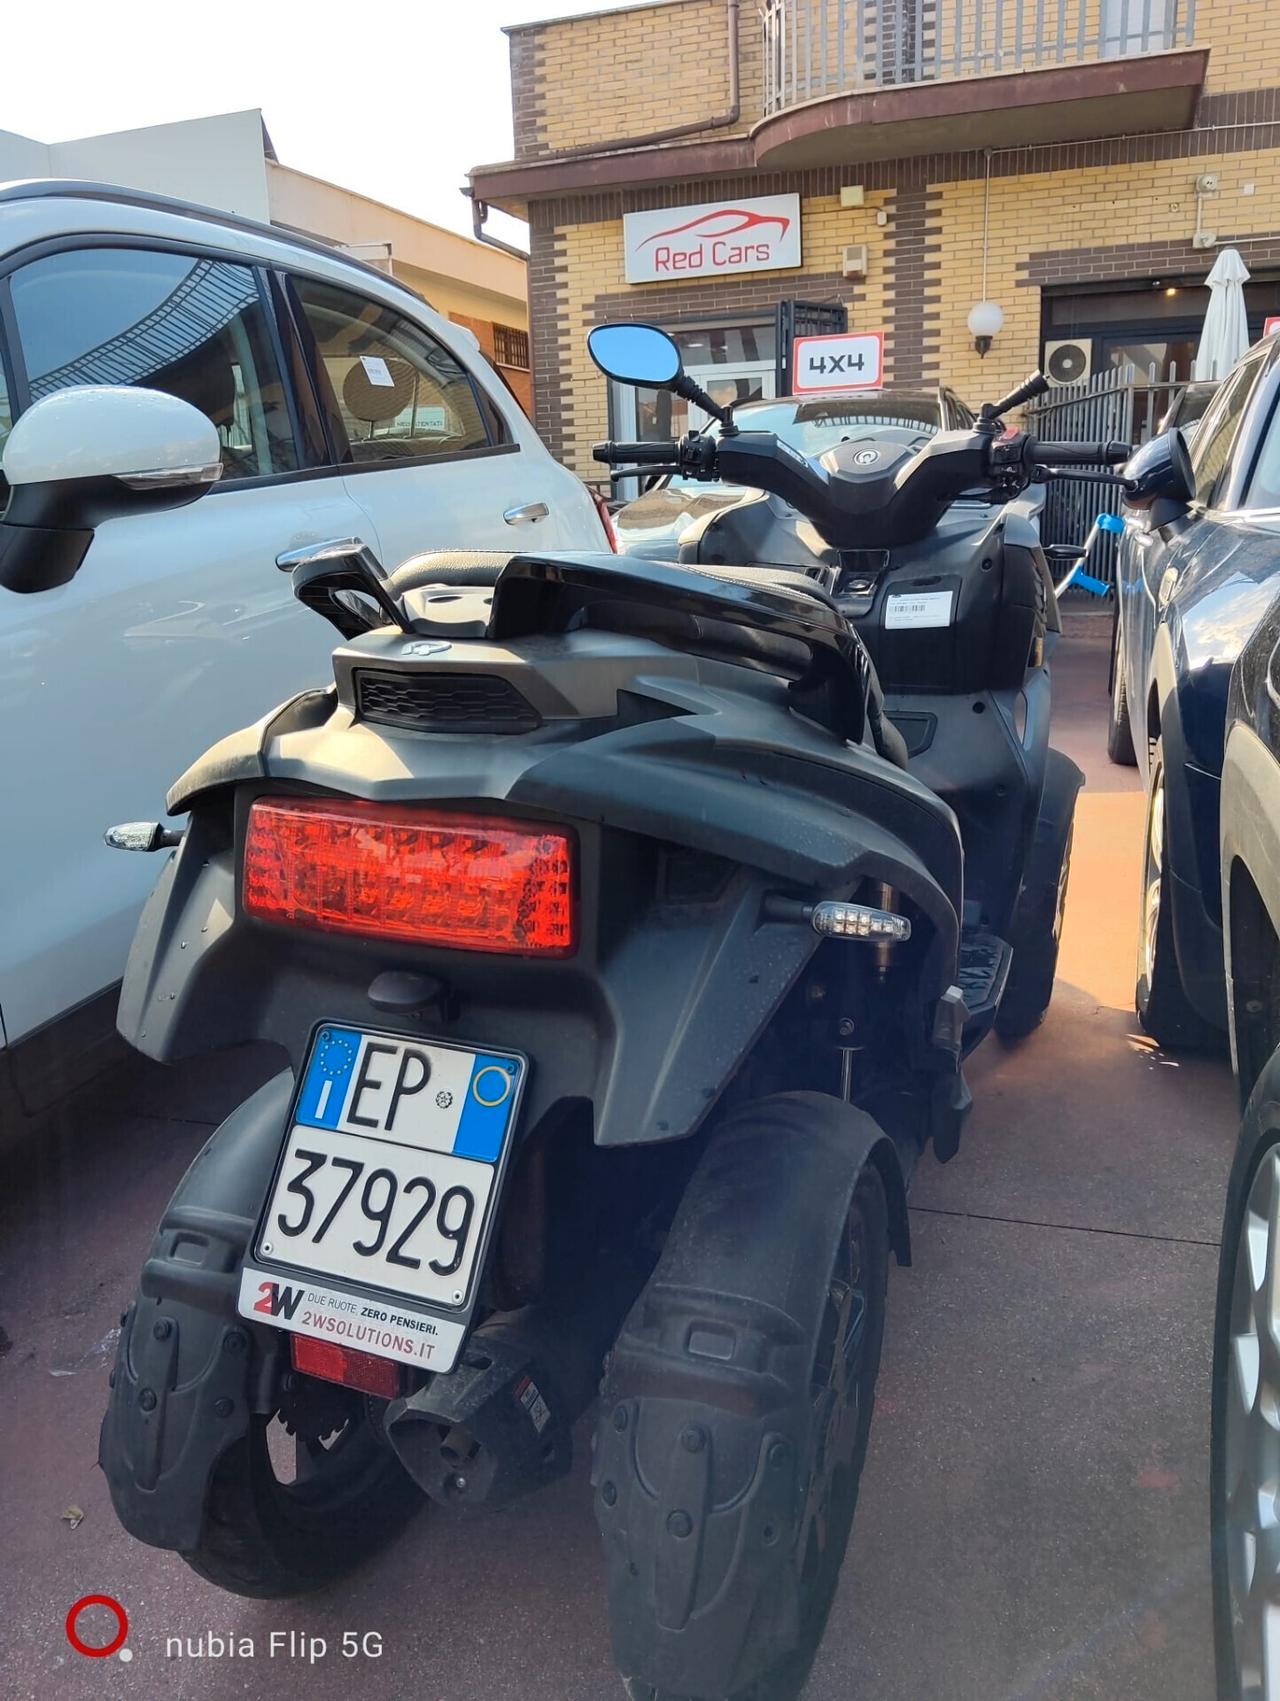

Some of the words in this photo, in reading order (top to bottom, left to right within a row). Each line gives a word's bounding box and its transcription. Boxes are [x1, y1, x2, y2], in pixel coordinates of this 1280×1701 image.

[655, 242, 704, 273] Red
[712, 241, 770, 266] Cars
[808, 353, 865, 374] 4X4
[346, 1041, 431, 1131] EP
[277, 1148, 475, 1276] 37929
[253, 1281, 305, 1320] 2W
[307, 1292, 326, 1306] DUE
[360, 1307, 388, 1322] ZERO
[389, 1314, 439, 1336] PENSIERI.
[301, 1311, 435, 1360] 2WSOLUTIONS.IT
